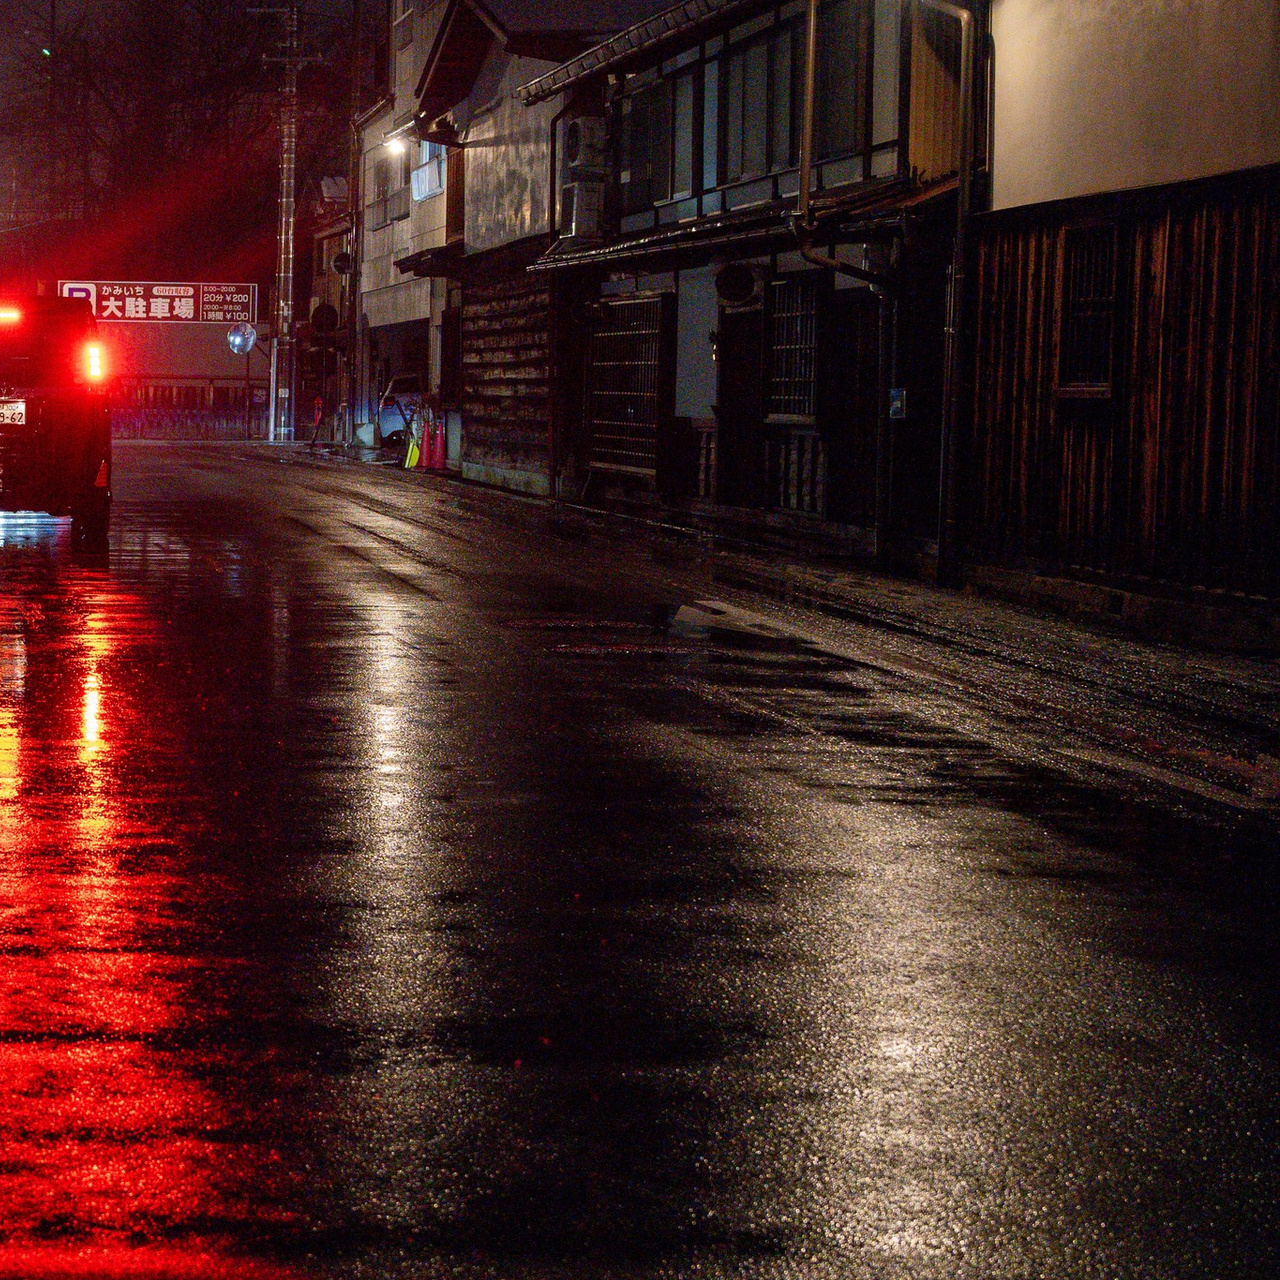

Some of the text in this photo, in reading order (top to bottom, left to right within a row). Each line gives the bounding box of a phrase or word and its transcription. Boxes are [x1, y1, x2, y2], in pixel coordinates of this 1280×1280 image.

[101, 285, 145, 296] かみいち
[203, 293, 249, 303] 20分 ¥200
[101, 296, 195, 319] 大駐車場
[203, 311, 249, 321] 1時間 ¥100
